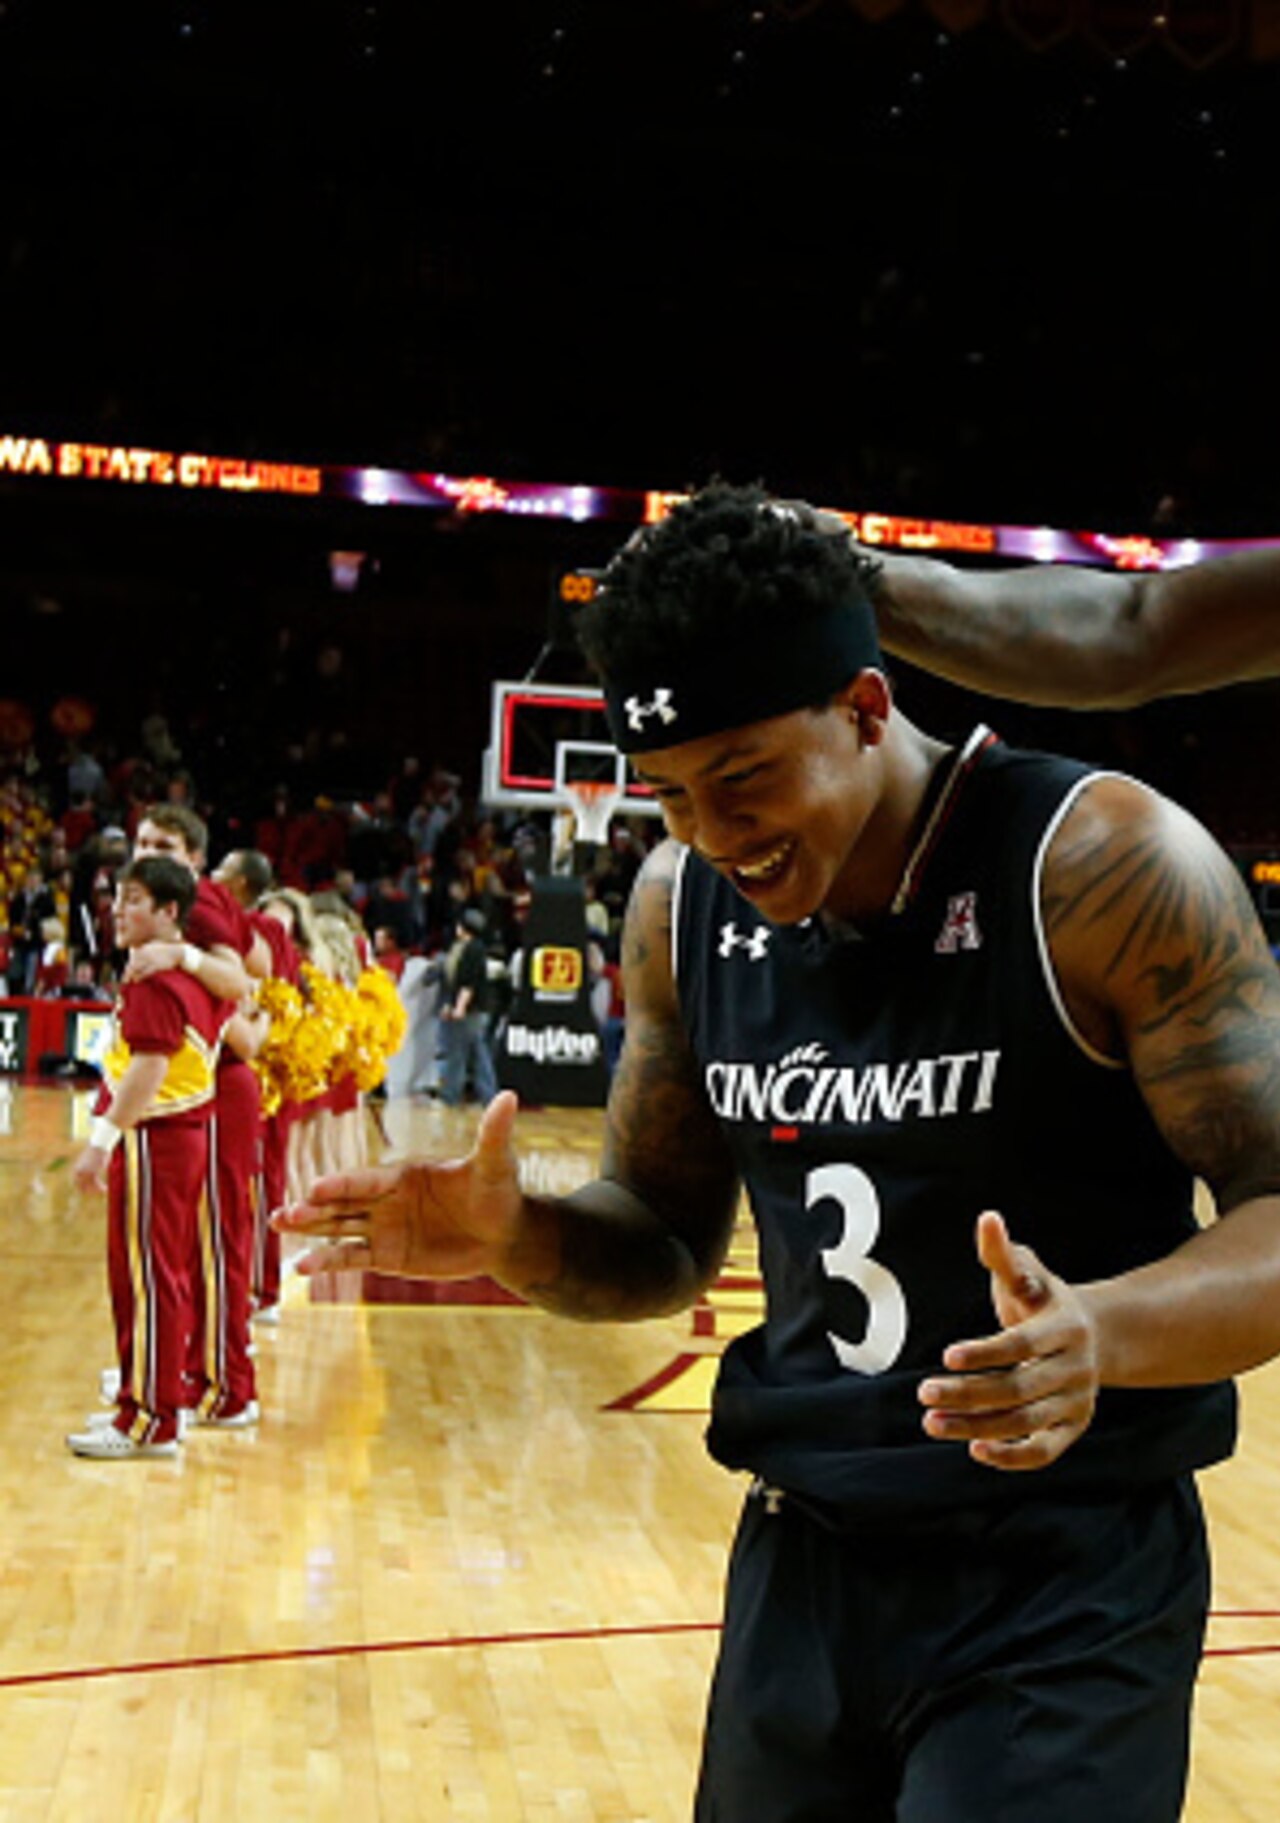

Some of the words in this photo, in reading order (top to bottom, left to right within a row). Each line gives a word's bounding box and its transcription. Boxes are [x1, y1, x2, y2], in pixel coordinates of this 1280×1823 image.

[57, 443, 175, 484] STATE
[179, 455, 320, 493] CYCLONES
[705, 1049, 1002, 1123] CINCINNATI
[803, 1161, 909, 1377] 3
